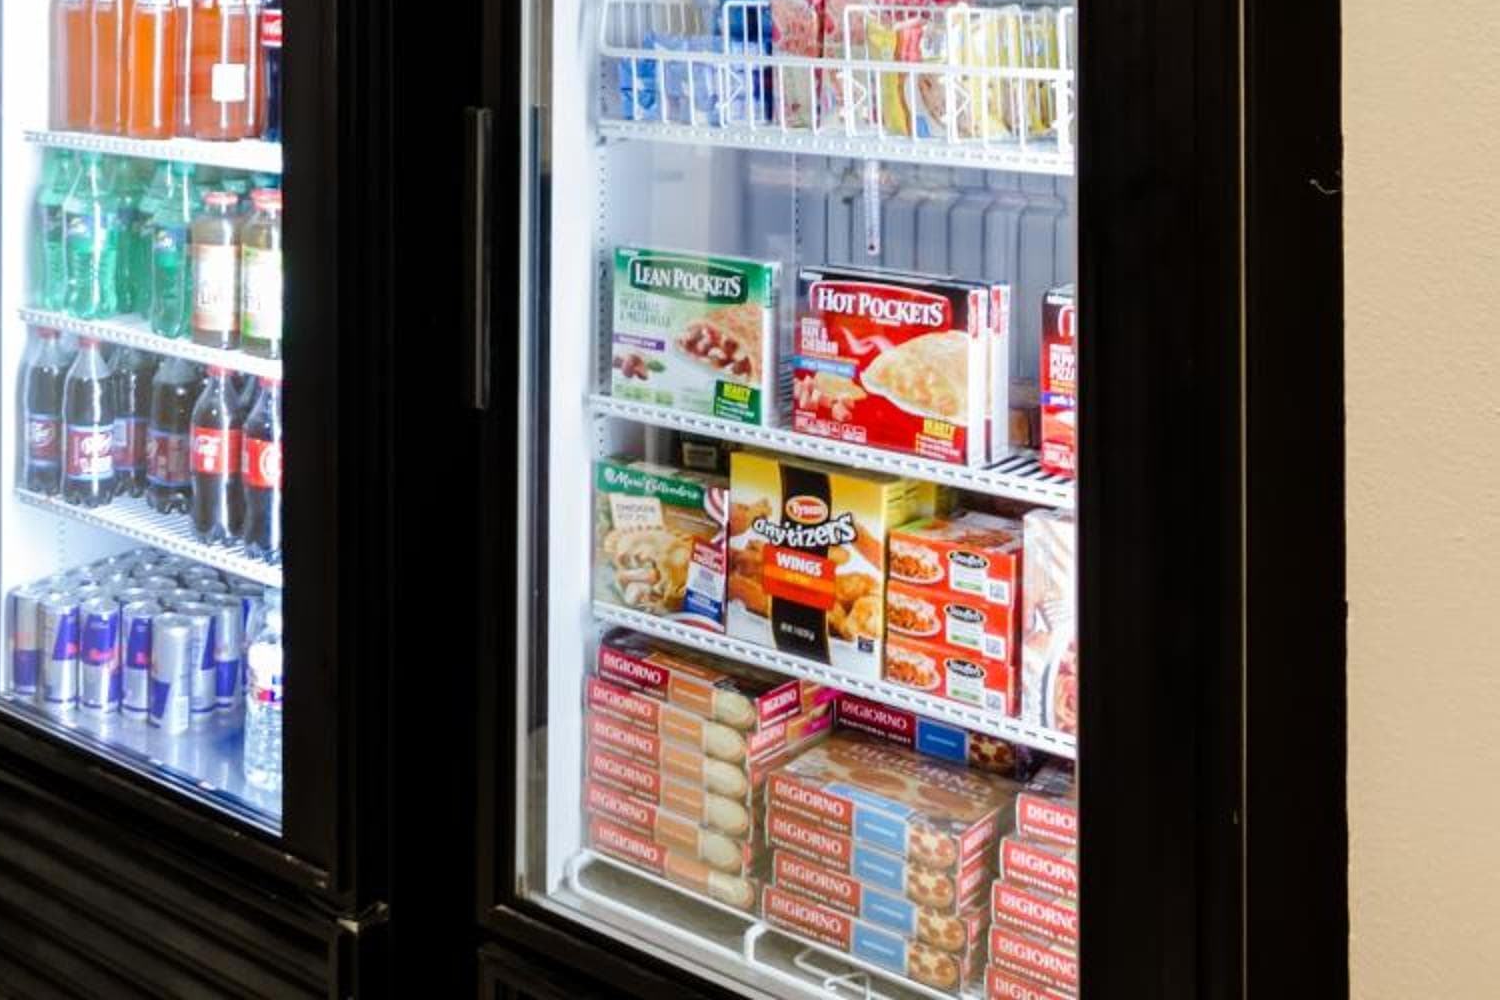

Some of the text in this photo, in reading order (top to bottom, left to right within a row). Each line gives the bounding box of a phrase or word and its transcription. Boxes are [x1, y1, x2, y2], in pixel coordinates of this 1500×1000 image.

[635, 262, 741, 297] LEAN POCKETS
[818, 287, 945, 327] HOT POCKETS
[775, 550, 824, 578] WINGS
[604, 652, 661, 685] DIGIORNO
[841, 700, 907, 730] DIGIORNO
[775, 780, 844, 818] DIGIORNO
[1028, 804, 1076, 830] DIGIO
[773, 819, 841, 854] DIGIORNO
[782, 861, 851, 897] DIGIORNO
[1011, 848, 1076, 882] DIGIORN
[771, 895, 841, 933] DIGIORNO
[995, 976, 1042, 1000] DIGIO
